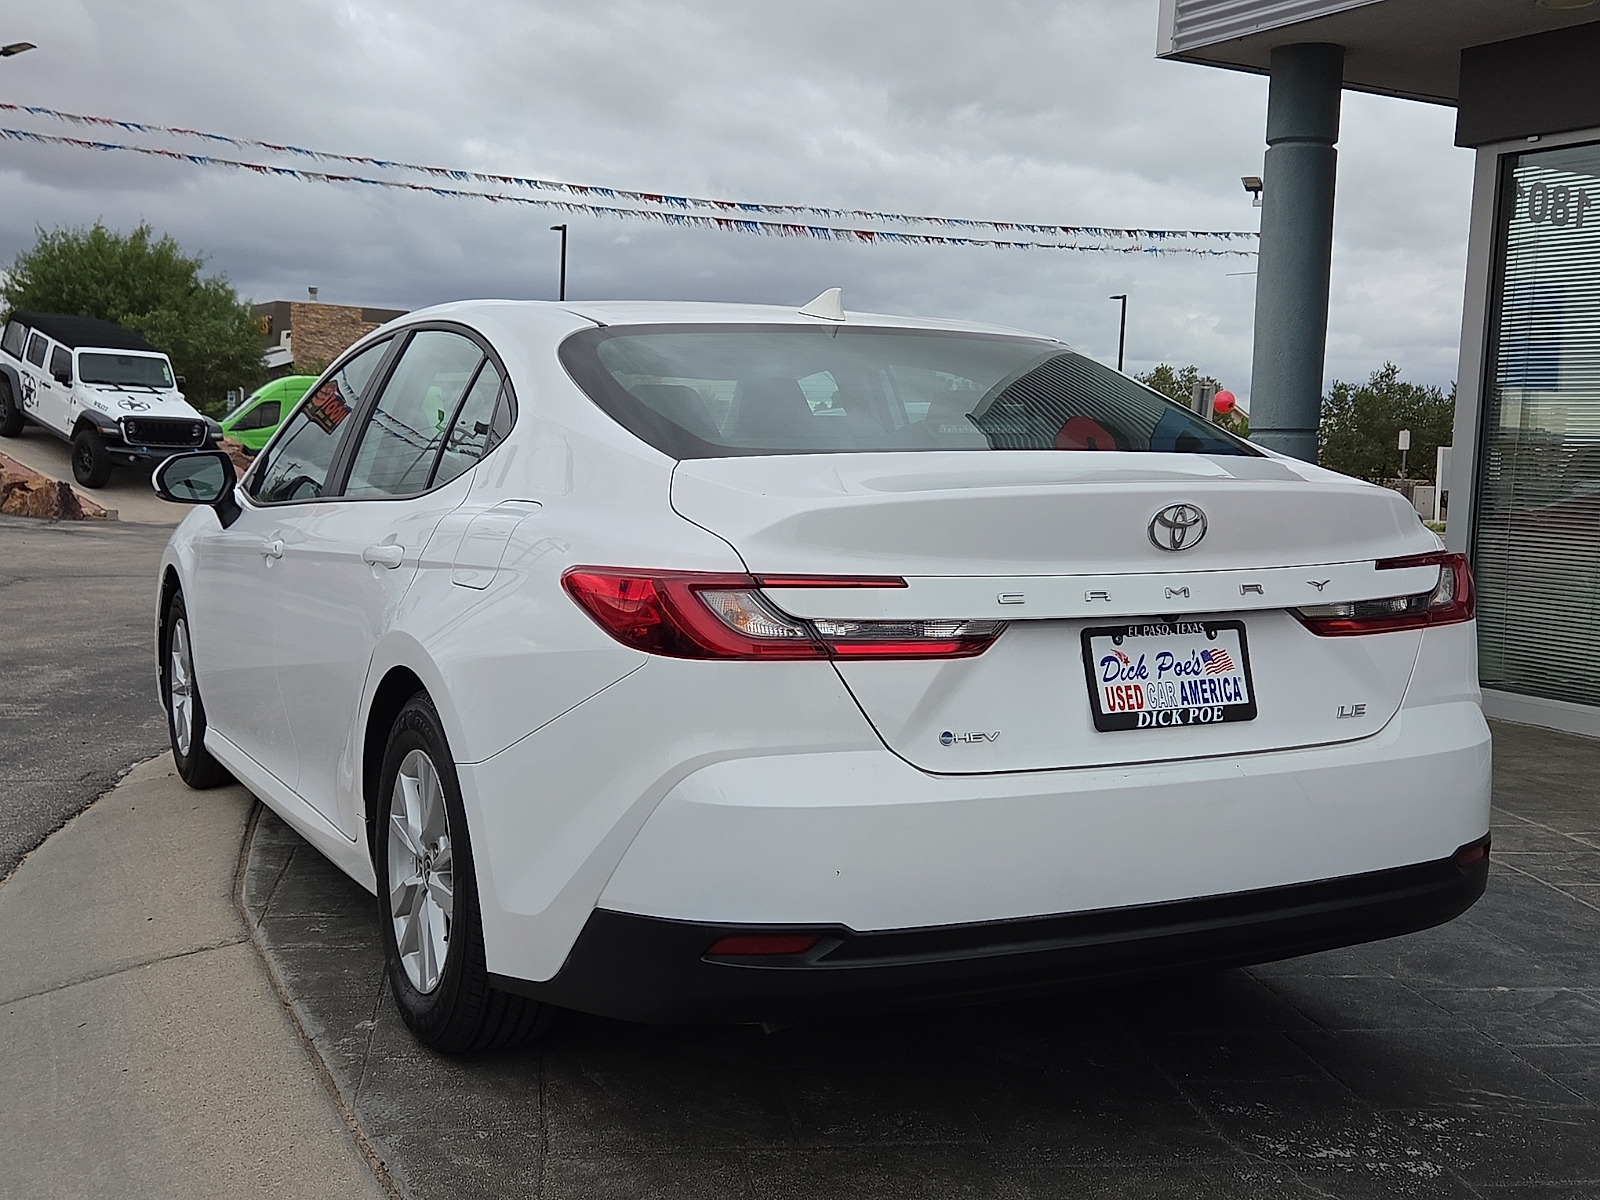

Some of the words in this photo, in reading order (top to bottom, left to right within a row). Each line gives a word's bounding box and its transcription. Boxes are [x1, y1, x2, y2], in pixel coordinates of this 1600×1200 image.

[998, 579, 1330, 604] CAMRY
[1128, 625, 1139, 636] EL
[1175, 622, 1205, 634] TEXAS
[1101, 654, 1149, 682] Dick
[1156, 650, 1202, 679] Poe's
[1106, 685, 1144, 711] USED
[1146, 681, 1178, 709] CAR
[1136, 709, 1184, 728] DICK
[1187, 706, 1224, 724] POE
[1337, 703, 1366, 719] LE
[954, 731, 1001, 743] HEV
